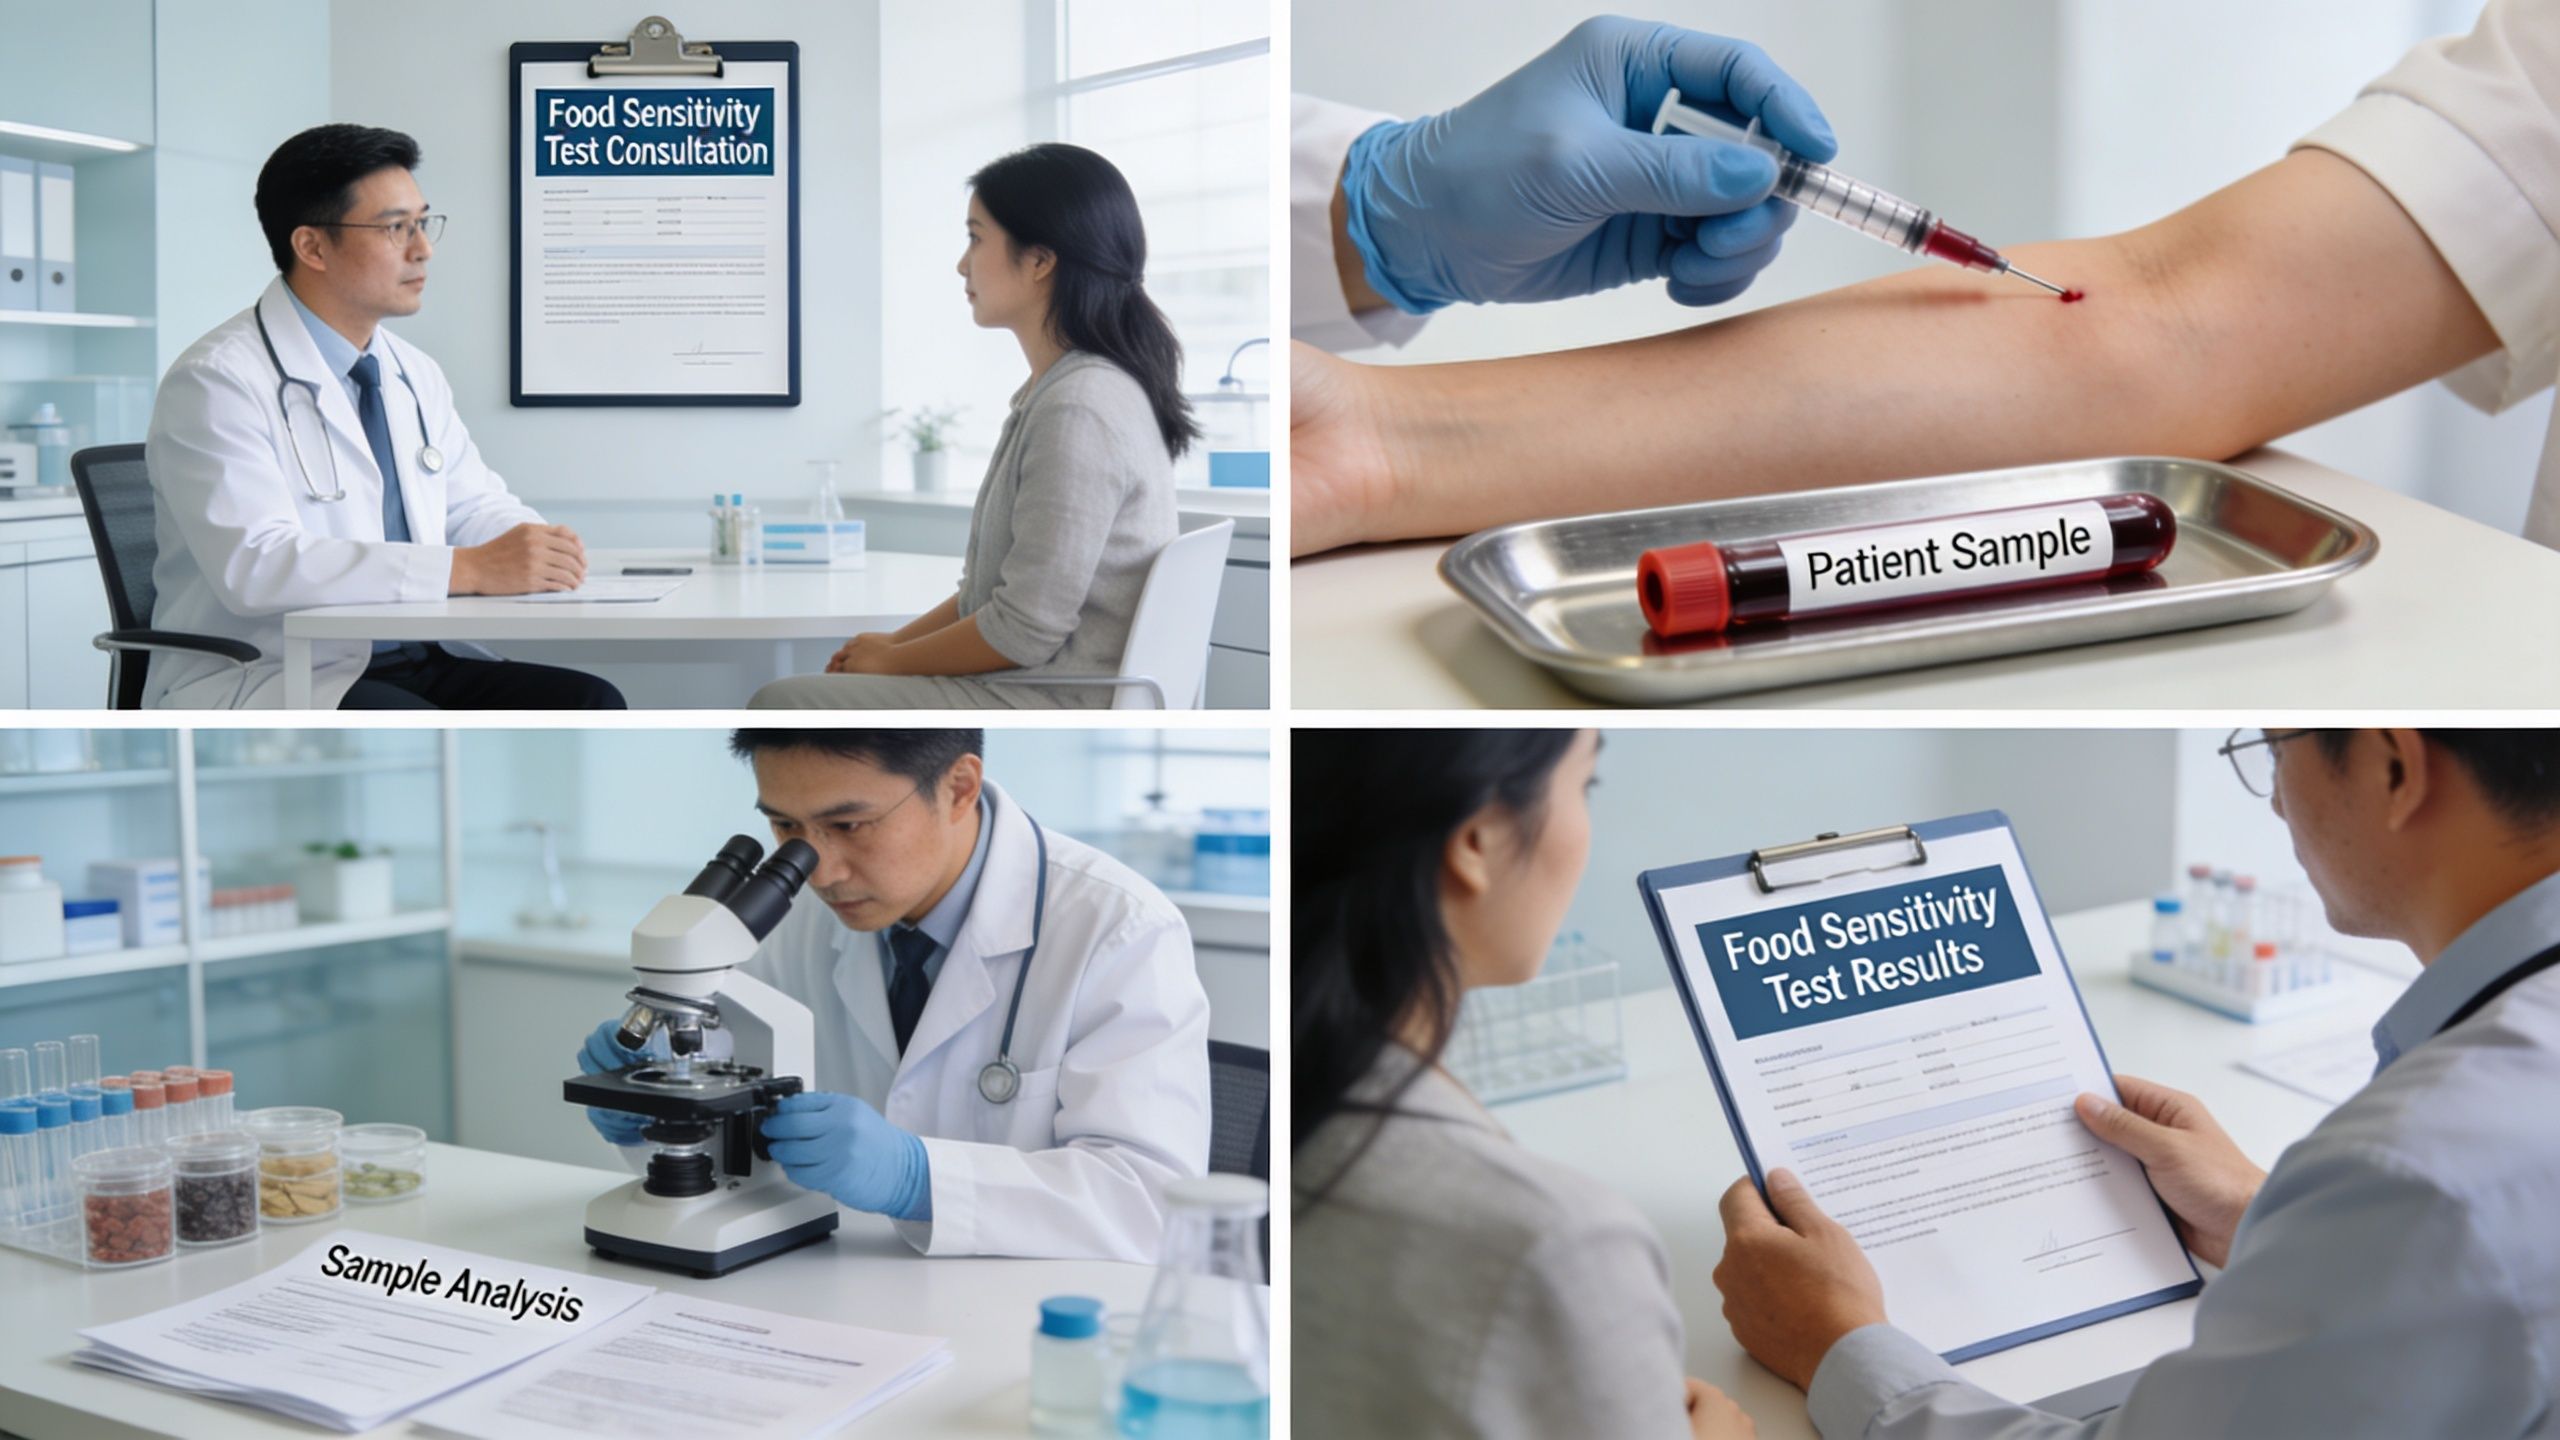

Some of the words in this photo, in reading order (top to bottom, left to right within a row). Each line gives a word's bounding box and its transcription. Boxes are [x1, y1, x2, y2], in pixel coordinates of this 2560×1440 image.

[543, 134, 600, 166] Test
[606, 134, 769, 165] Consultation
[548, 95, 616, 128] Food
[622, 97, 761, 135] Sensitivity
[1806, 538, 1942, 591] Patient
[1951, 518, 2092, 571] Sample
[1722, 915, 1817, 971] Food
[1819, 885, 1998, 950] Sensitivity
[1762, 964, 1849, 1014] Test
[1850, 939, 1985, 997] Results
[320, 1244, 442, 1298] Sample
[444, 1267, 584, 1323] Analysis
